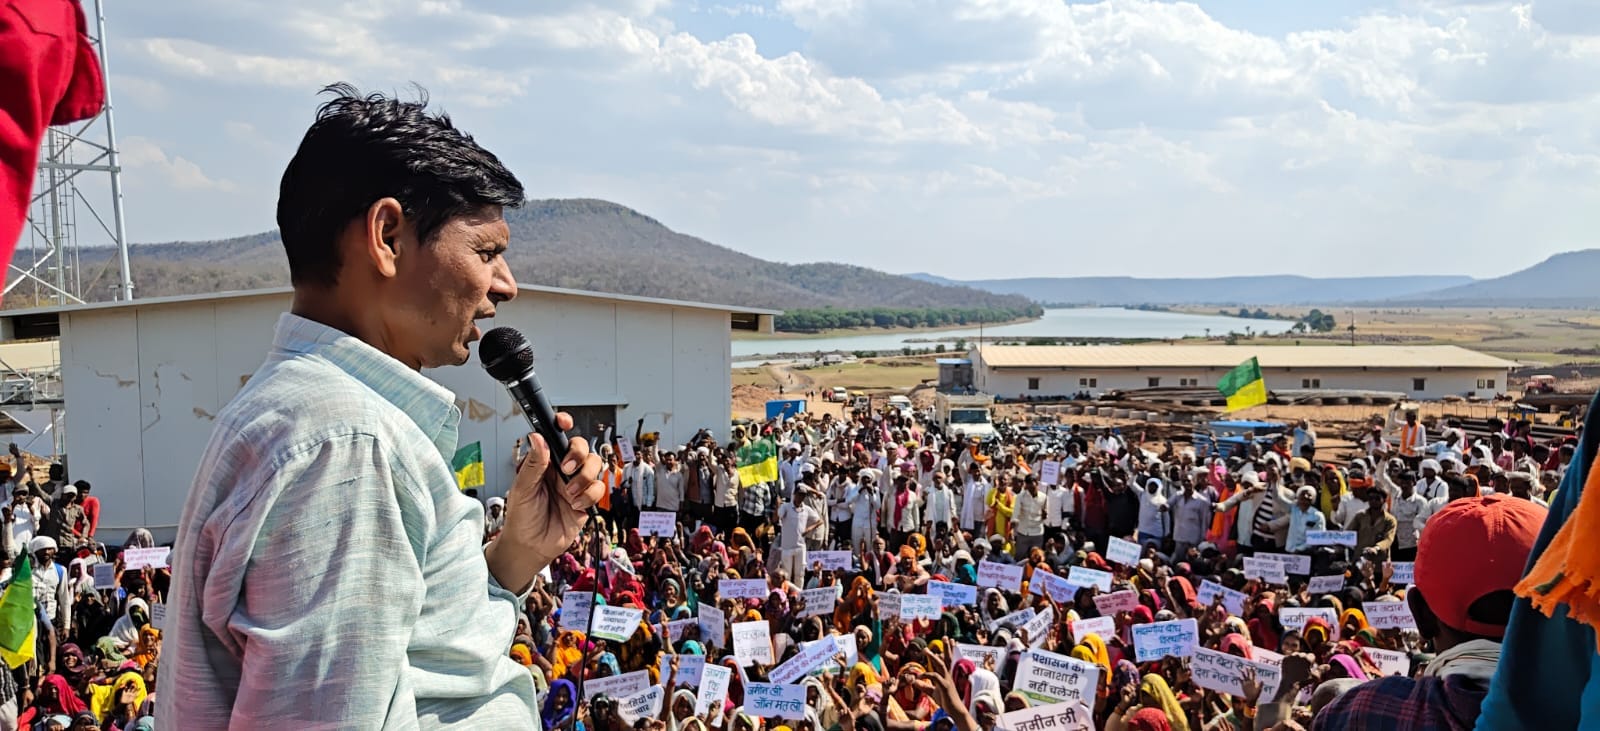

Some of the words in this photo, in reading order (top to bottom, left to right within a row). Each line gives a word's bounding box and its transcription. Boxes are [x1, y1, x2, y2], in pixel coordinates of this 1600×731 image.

[1032, 652, 1070, 671] प्रशासन
[1032, 665, 1079, 685] तानाशाही
[1028, 680, 1048, 693] नहीं
[1049, 684, 1080, 700] चलेगी
[1057, 707, 1078, 725] ली
